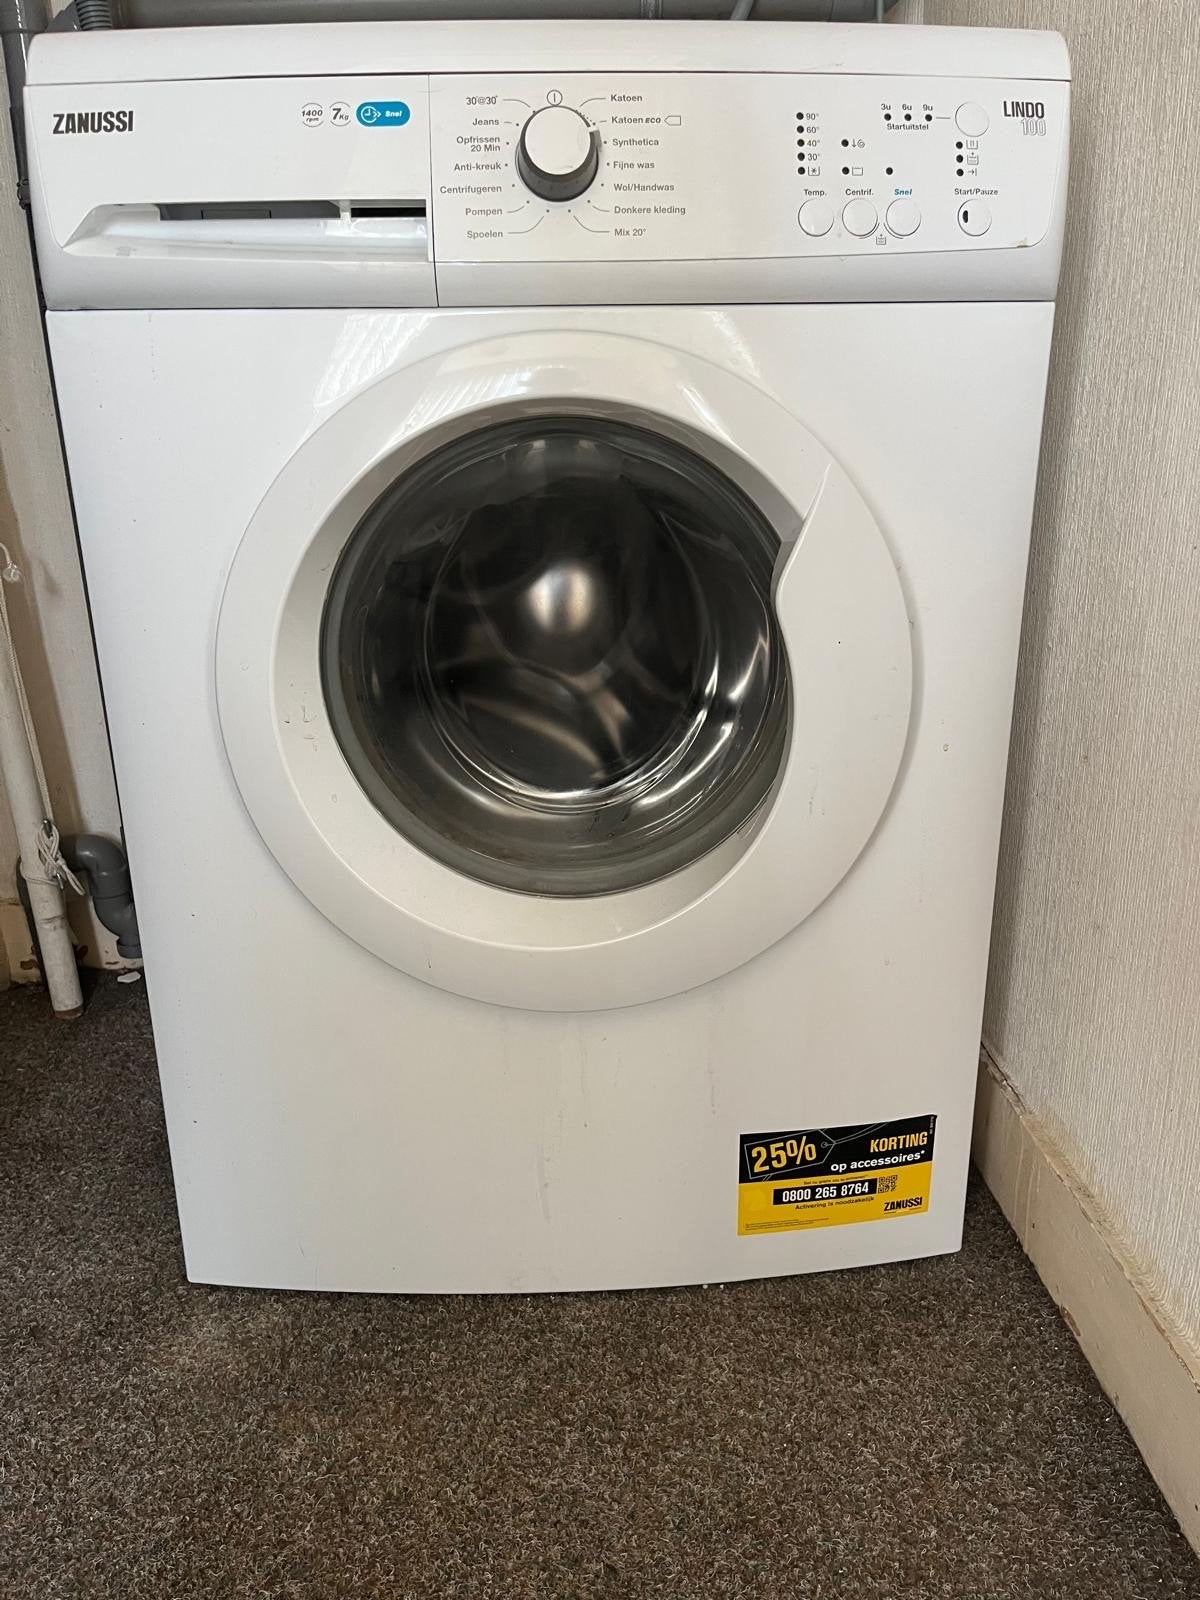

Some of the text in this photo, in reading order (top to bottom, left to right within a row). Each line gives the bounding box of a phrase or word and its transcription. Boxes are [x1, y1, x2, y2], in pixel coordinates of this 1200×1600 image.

[1003, 101, 1044, 119] LINDO
[53, 111, 134, 134] ZANUSSI
[1021, 118, 1046, 136] 100
[456, 136, 500, 145] Opfrissen
[612, 138, 659, 147] Synthetica
[454, 162, 501, 171] Anti-kreuk
[613, 161, 634, 170] Fijne
[440, 185, 502, 195] Centrifugeren
[614, 183, 674, 191] Wol/Handwas
[466, 208, 502, 217] Pompen
[614, 206, 686, 216] Donkere kleding
[467, 230, 503, 239] Spoelen
[870, 1131, 928, 1153] KORTING
[751, 1136, 816, 1173] 25%
[830, 1162, 847, 1173] op
[782, 1182, 869, 1202] 0800 265 8764
[884, 1197, 922, 1211] ZANUSSI
